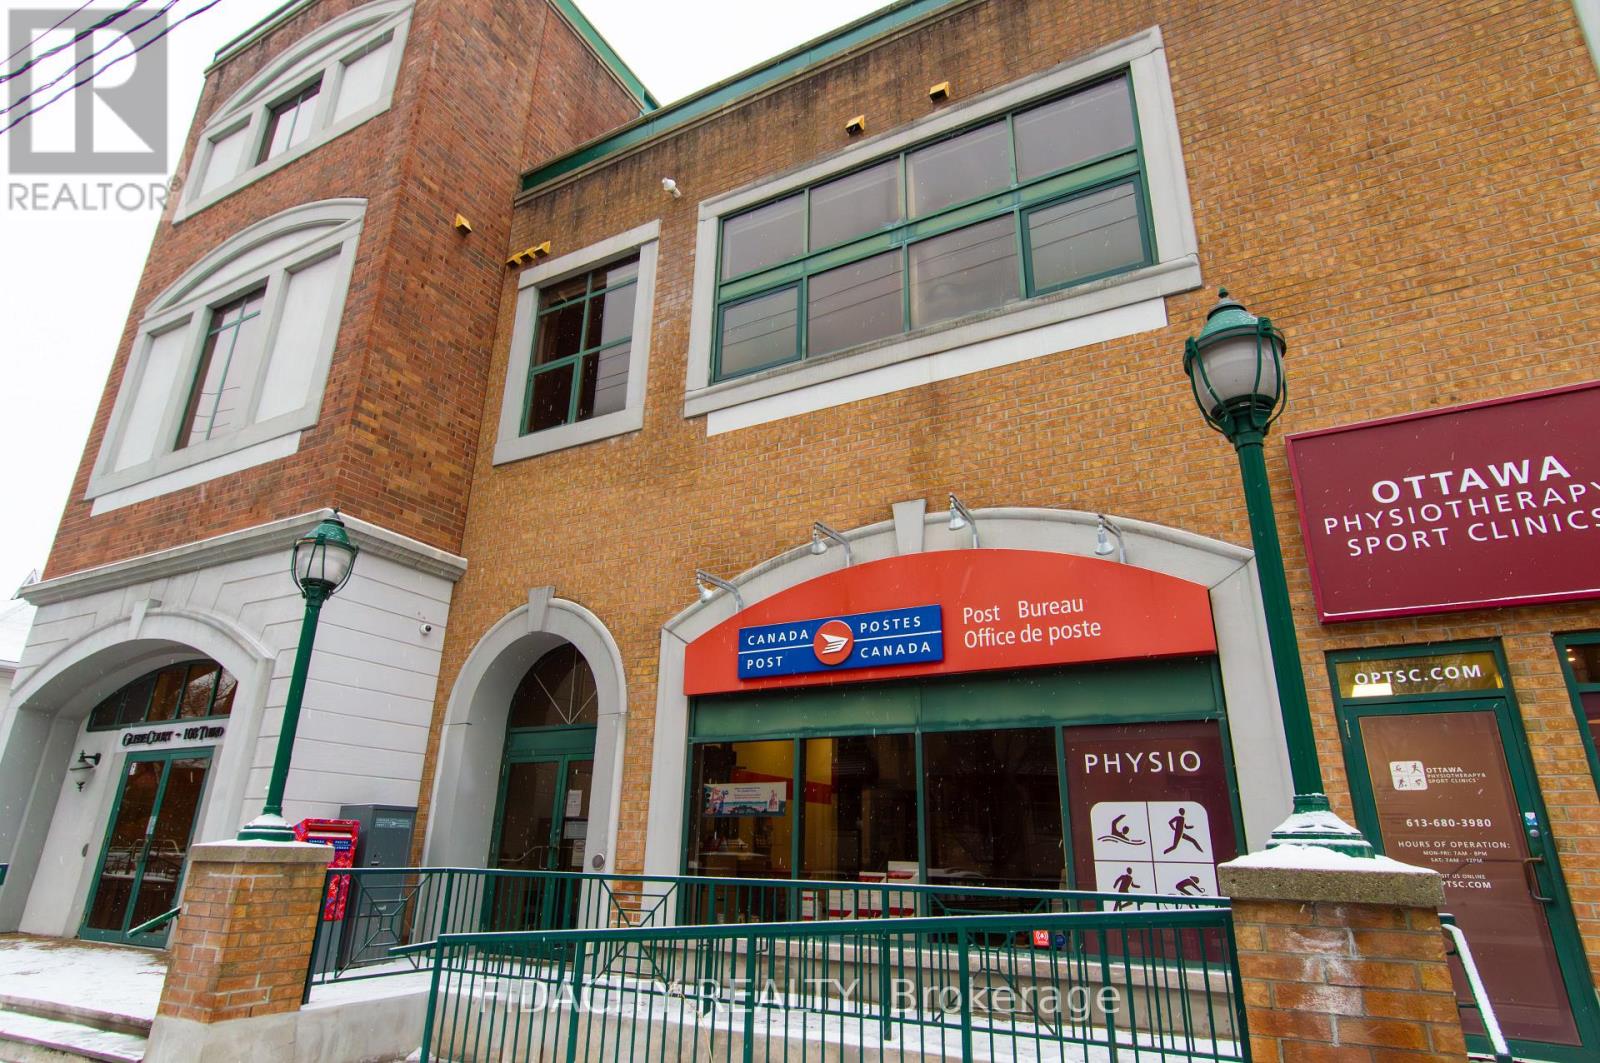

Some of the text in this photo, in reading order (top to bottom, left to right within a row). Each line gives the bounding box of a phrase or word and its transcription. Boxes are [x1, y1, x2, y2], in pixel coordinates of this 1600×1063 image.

[1372, 455, 1571, 503] OTTAWA
[1347, 527, 1449, 557] SPORT
[963, 598, 1084, 625] Post Bureau
[860, 616, 921, 633] POSTES
[964, 621, 1101, 648] Office de poste
[748, 628, 809, 646] CANADA
[860, 642, 931, 659] CANADA
[747, 656, 784, 670] POST
[1354, 664, 1482, 686] OPTSC.COM
[1085, 750, 1202, 774] PHYSIO
[1406, 818, 1492, 828] 613-680-3980
[1450, 841, 1511, 849] OPERATION:
